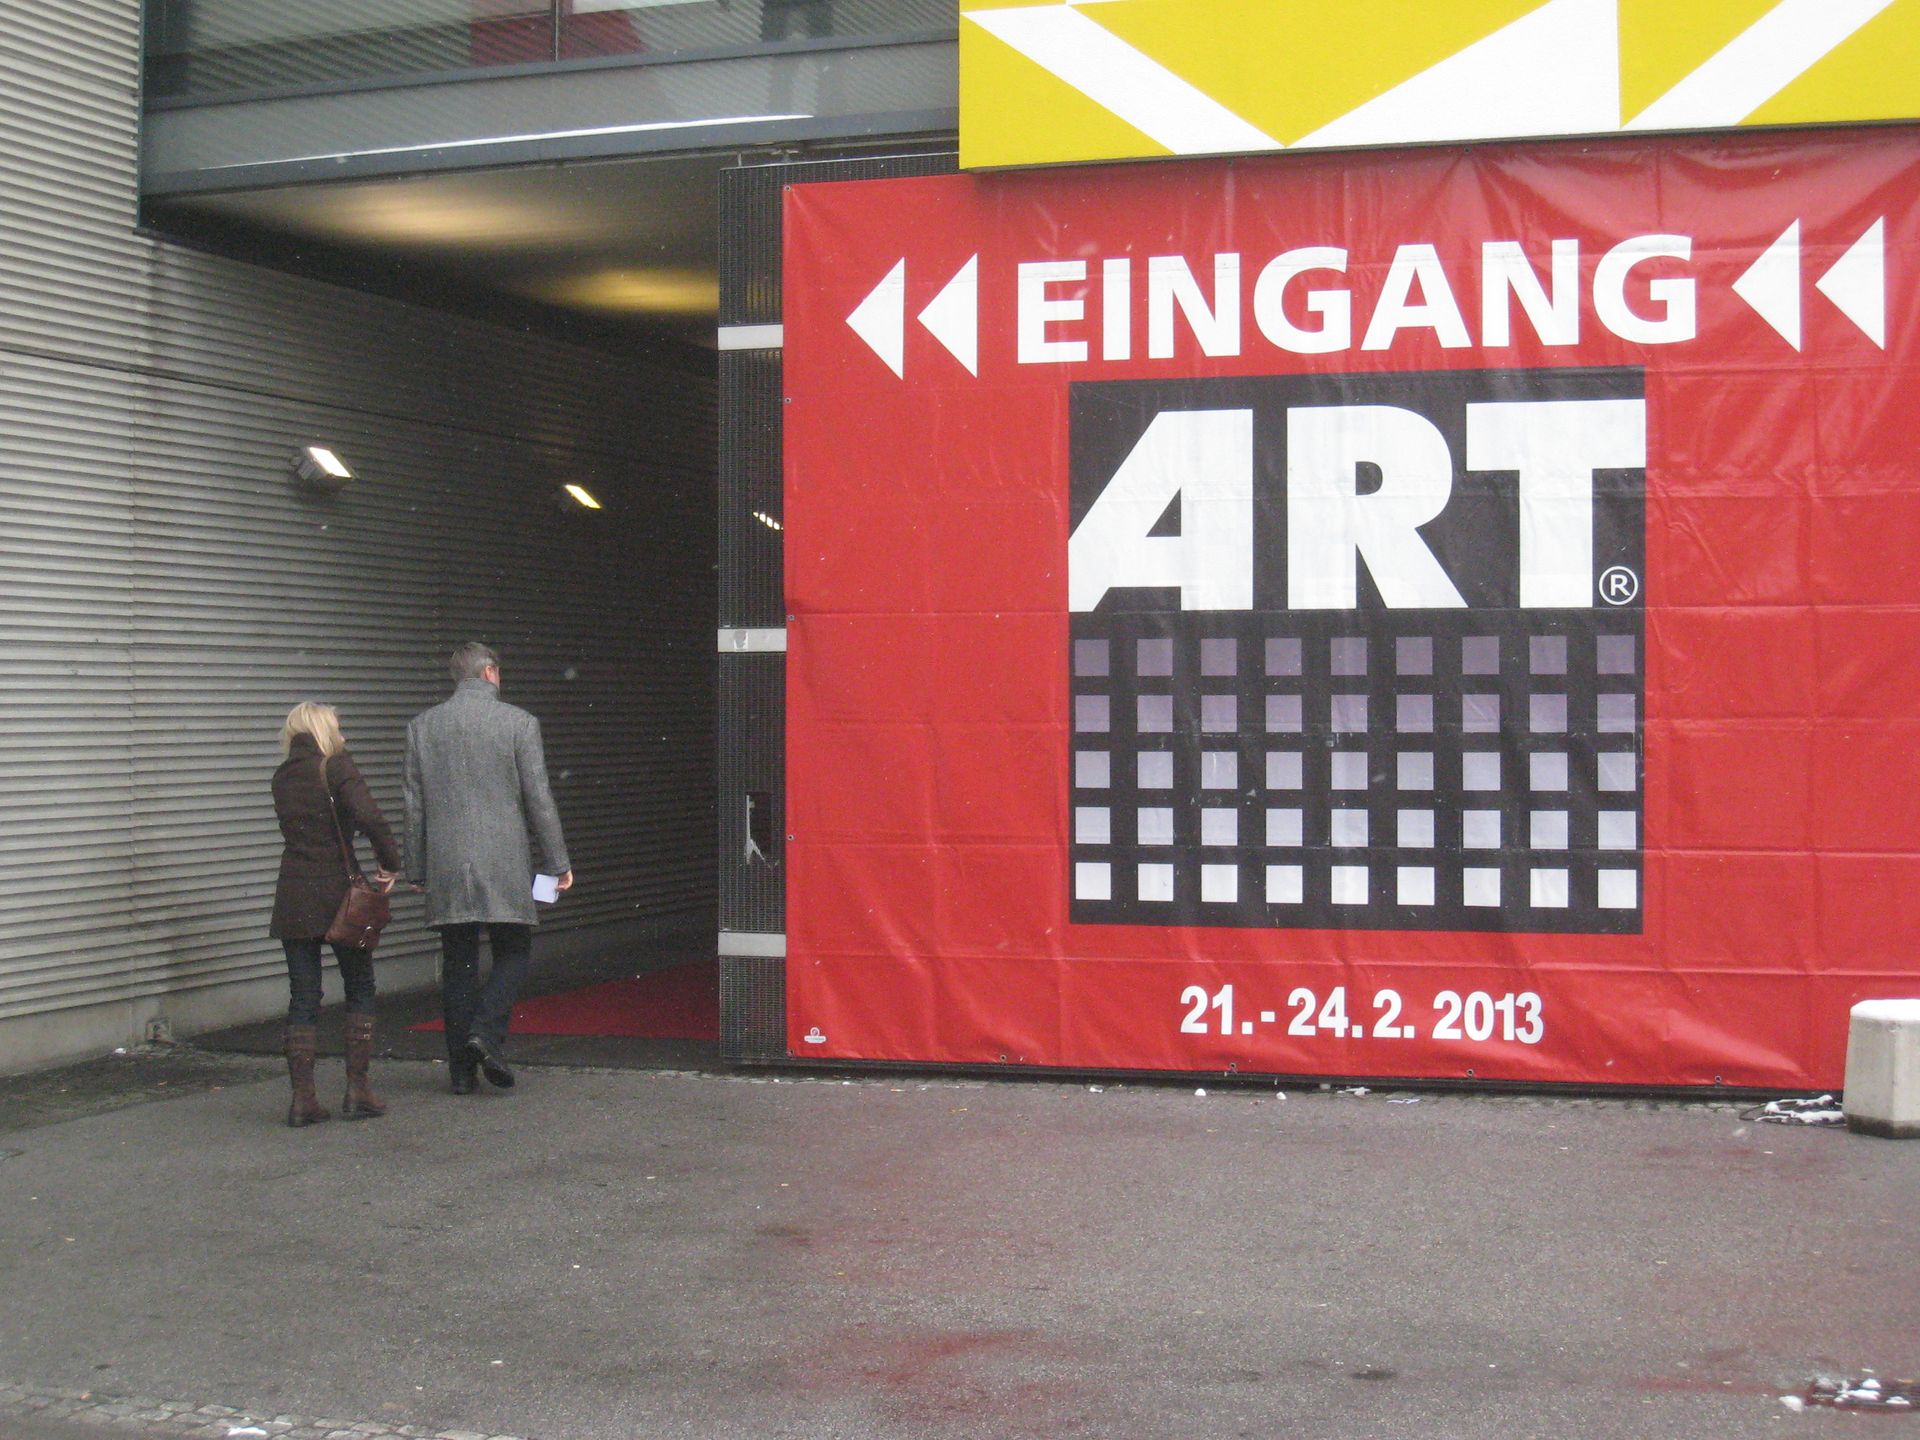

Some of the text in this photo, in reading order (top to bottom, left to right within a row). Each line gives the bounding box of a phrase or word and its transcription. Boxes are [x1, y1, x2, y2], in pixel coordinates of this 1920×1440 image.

[1016, 232, 1698, 365] EINGANG
[1067, 398, 1648, 613] ART
[1431, 989, 1544, 1045] 2013
